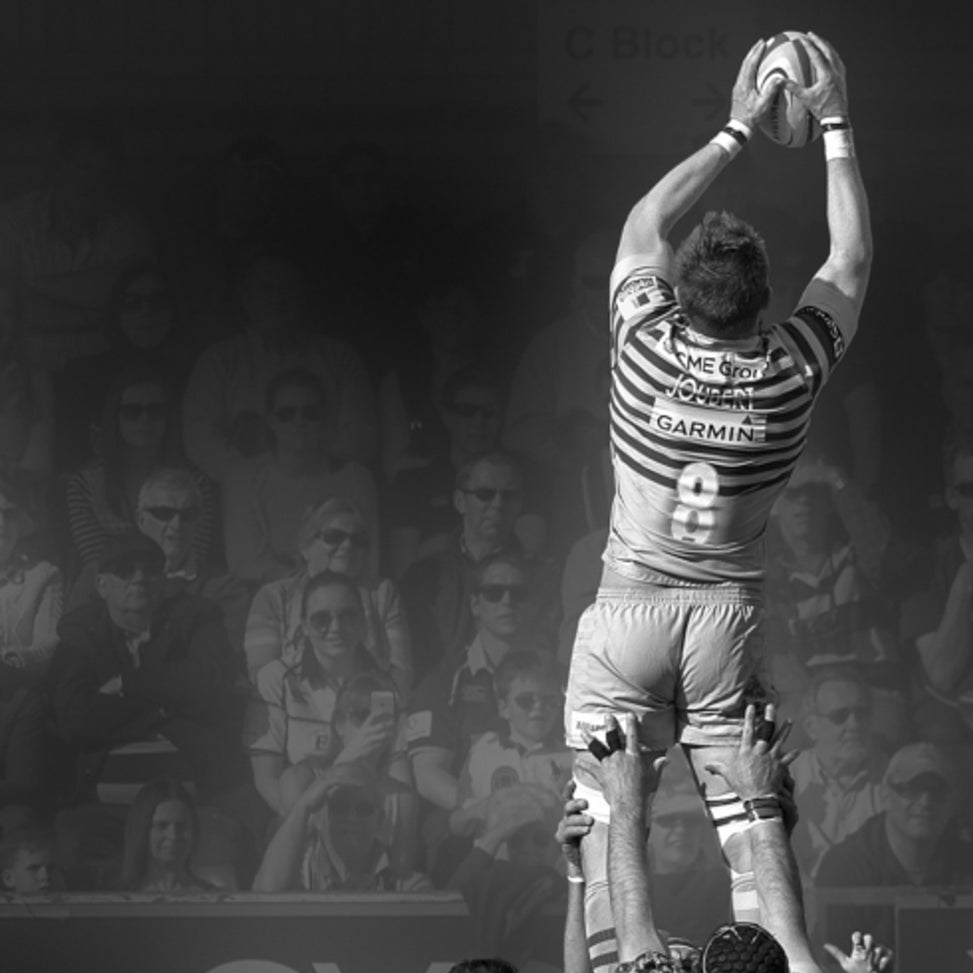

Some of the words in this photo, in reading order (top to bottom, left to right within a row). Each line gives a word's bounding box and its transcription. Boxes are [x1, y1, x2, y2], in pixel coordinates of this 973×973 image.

[565, 25, 595, 61] C
[610, 24, 729, 60] Block
[656, 414, 754, 443] GARMIN
[671, 462, 720, 545] 8
